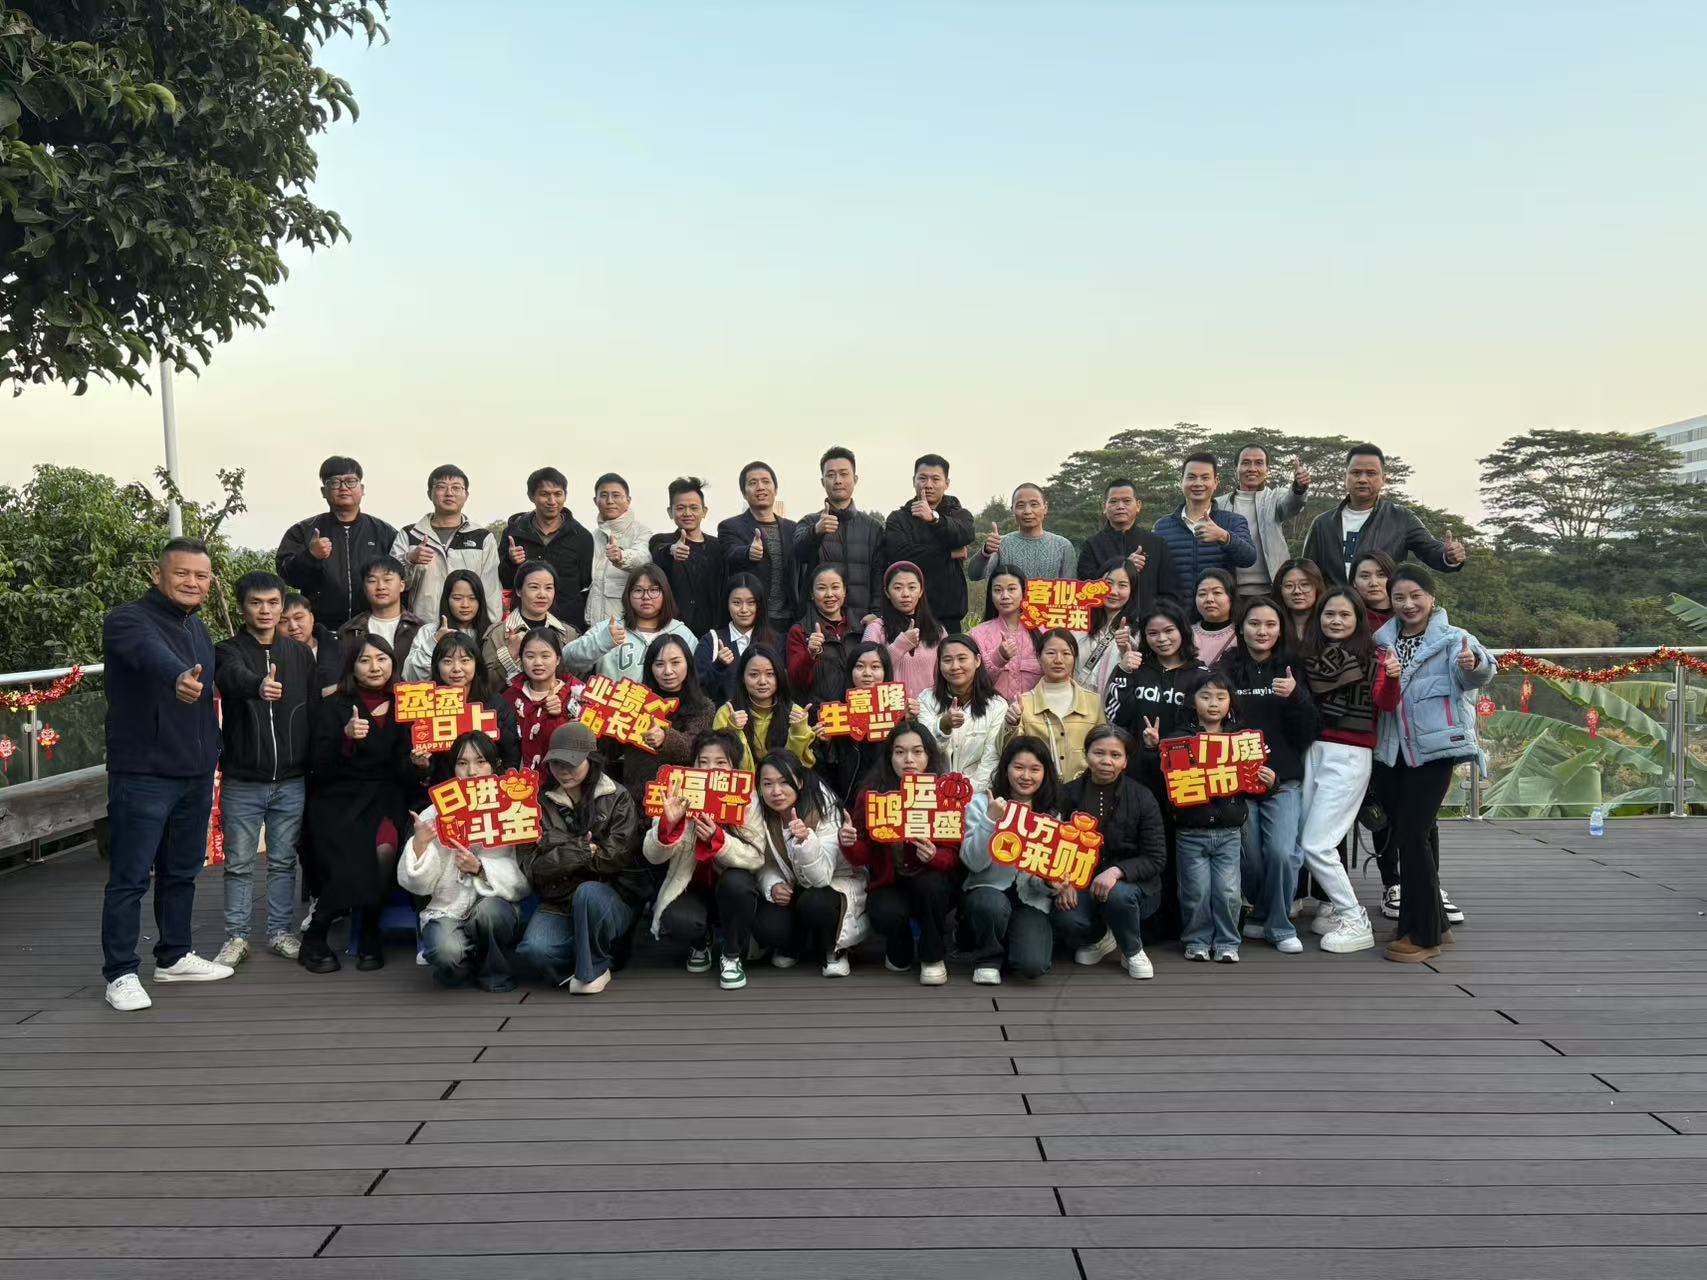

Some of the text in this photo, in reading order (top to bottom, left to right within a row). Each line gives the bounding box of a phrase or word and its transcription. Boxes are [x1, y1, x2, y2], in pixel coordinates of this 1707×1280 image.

[1027, 580, 1078, 605] 客似
[1046, 608, 1089, 629] 云来
[396, 683, 465, 719] 蒸蒸
[583, 676, 649, 719] 业绩
[820, 689, 873, 734] 生意
[432, 705, 498, 742] 日上
[1199, 732, 1264, 764] 门庭
[432, 778, 500, 816] 日进
[868, 775, 938, 828] 鸿运
[1168, 765, 1239, 804] 若市
[467, 800, 539, 845] 斗金
[904, 810, 961, 839] 昌盛
[998, 802, 1059, 844] 八方
[1019, 839, 1097, 886] 来财
